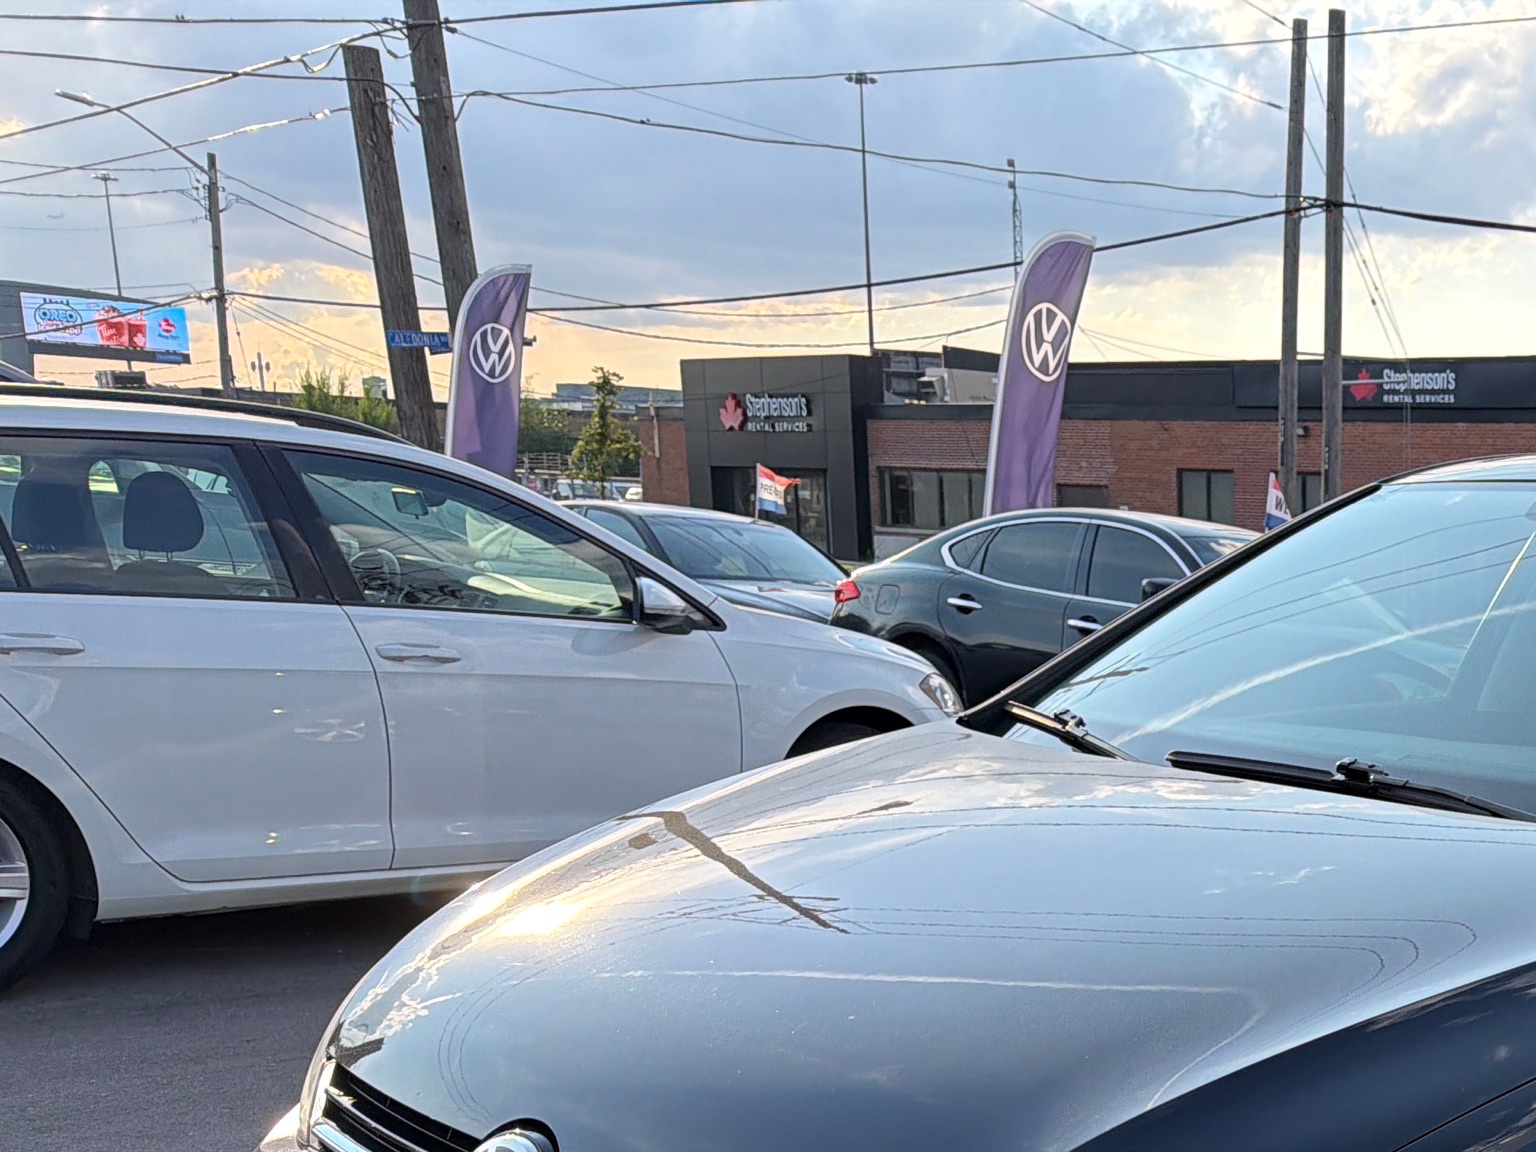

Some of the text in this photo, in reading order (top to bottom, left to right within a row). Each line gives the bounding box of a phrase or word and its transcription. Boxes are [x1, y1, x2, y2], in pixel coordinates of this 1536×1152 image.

[38, 308, 80, 323] OREO
[387, 332, 441, 347] CALEDONIA
[1383, 368, 1456, 392] Stephenson's
[745, 393, 808, 419] Stephenson's
[1383, 394, 1455, 403] RENTAL SERVICES
[747, 422, 808, 432] RENTAL SERVICES
